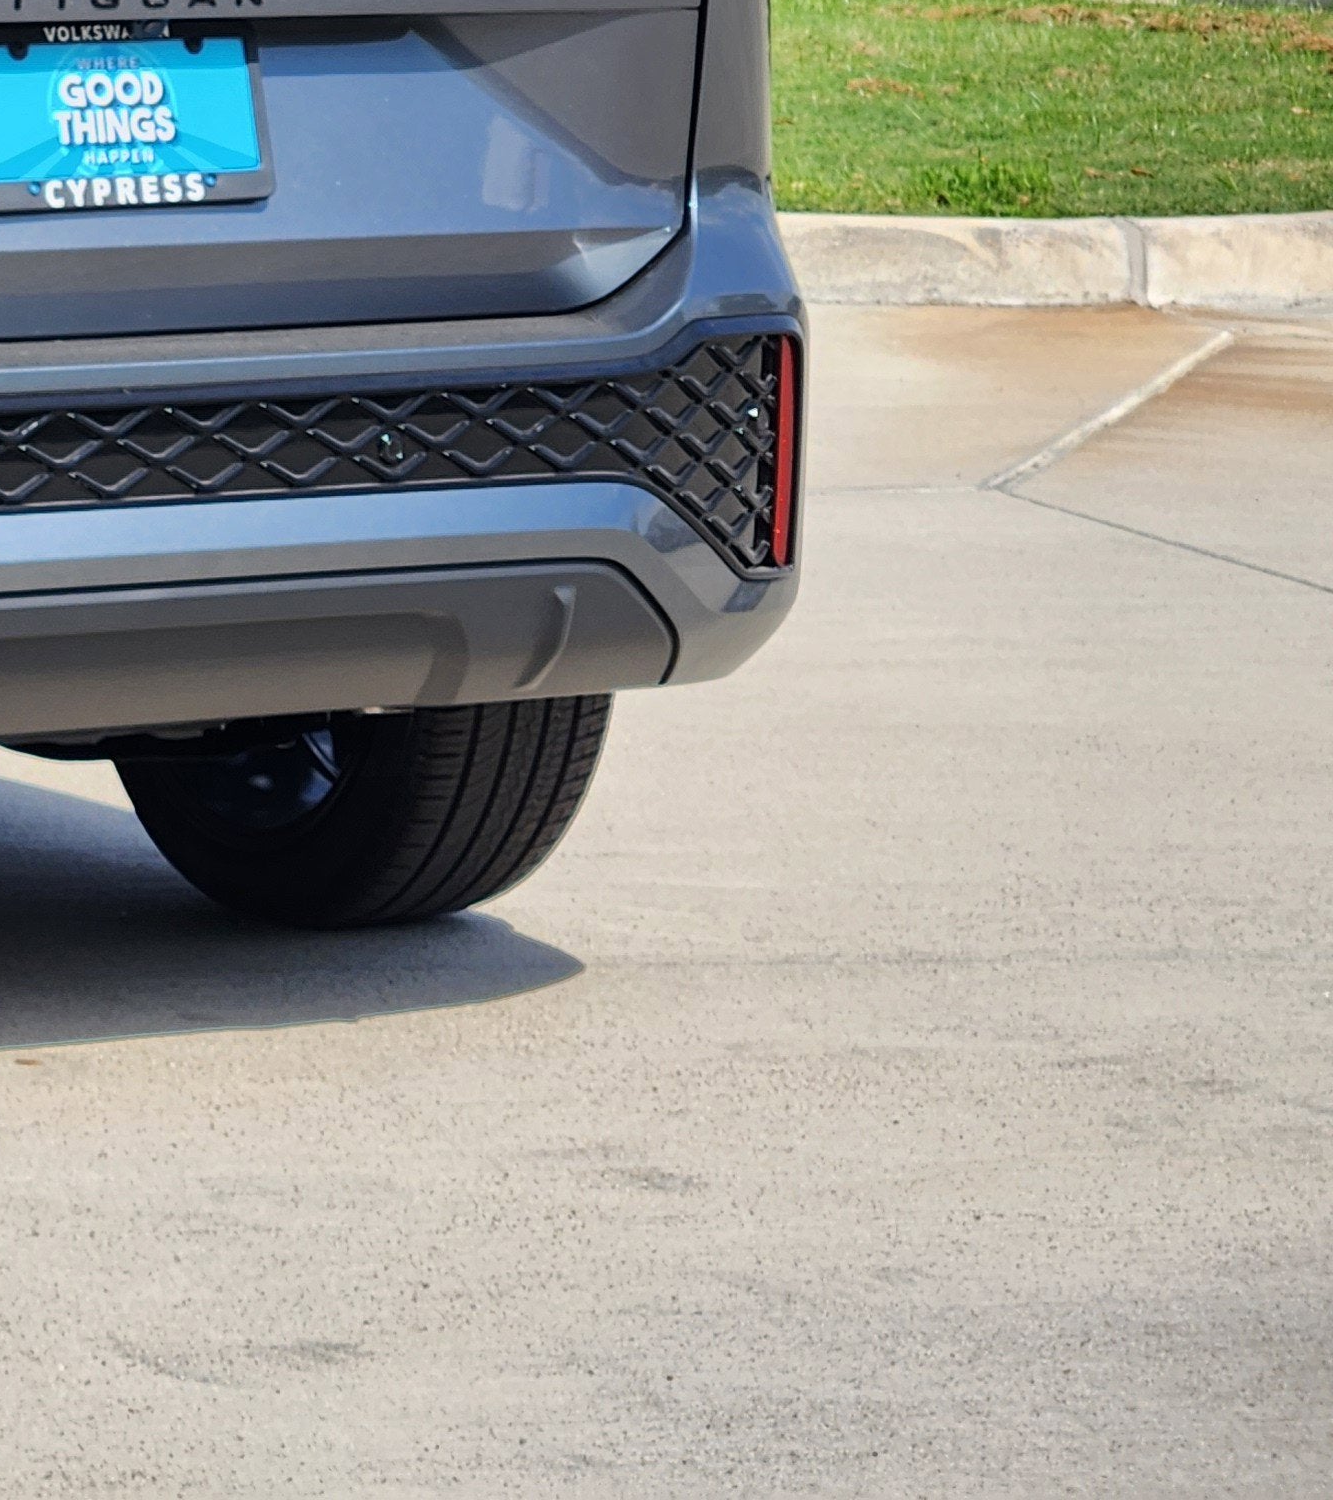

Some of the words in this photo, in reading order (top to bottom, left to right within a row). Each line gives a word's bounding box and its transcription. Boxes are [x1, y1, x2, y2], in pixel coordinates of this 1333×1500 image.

[77, 57, 140, 70] WHERE
[58, 71, 164, 108] GOOD
[53, 106, 176, 145] THINGS
[84, 148, 155, 164] HAPPEN
[44, 173, 206, 209] CYPRESS
